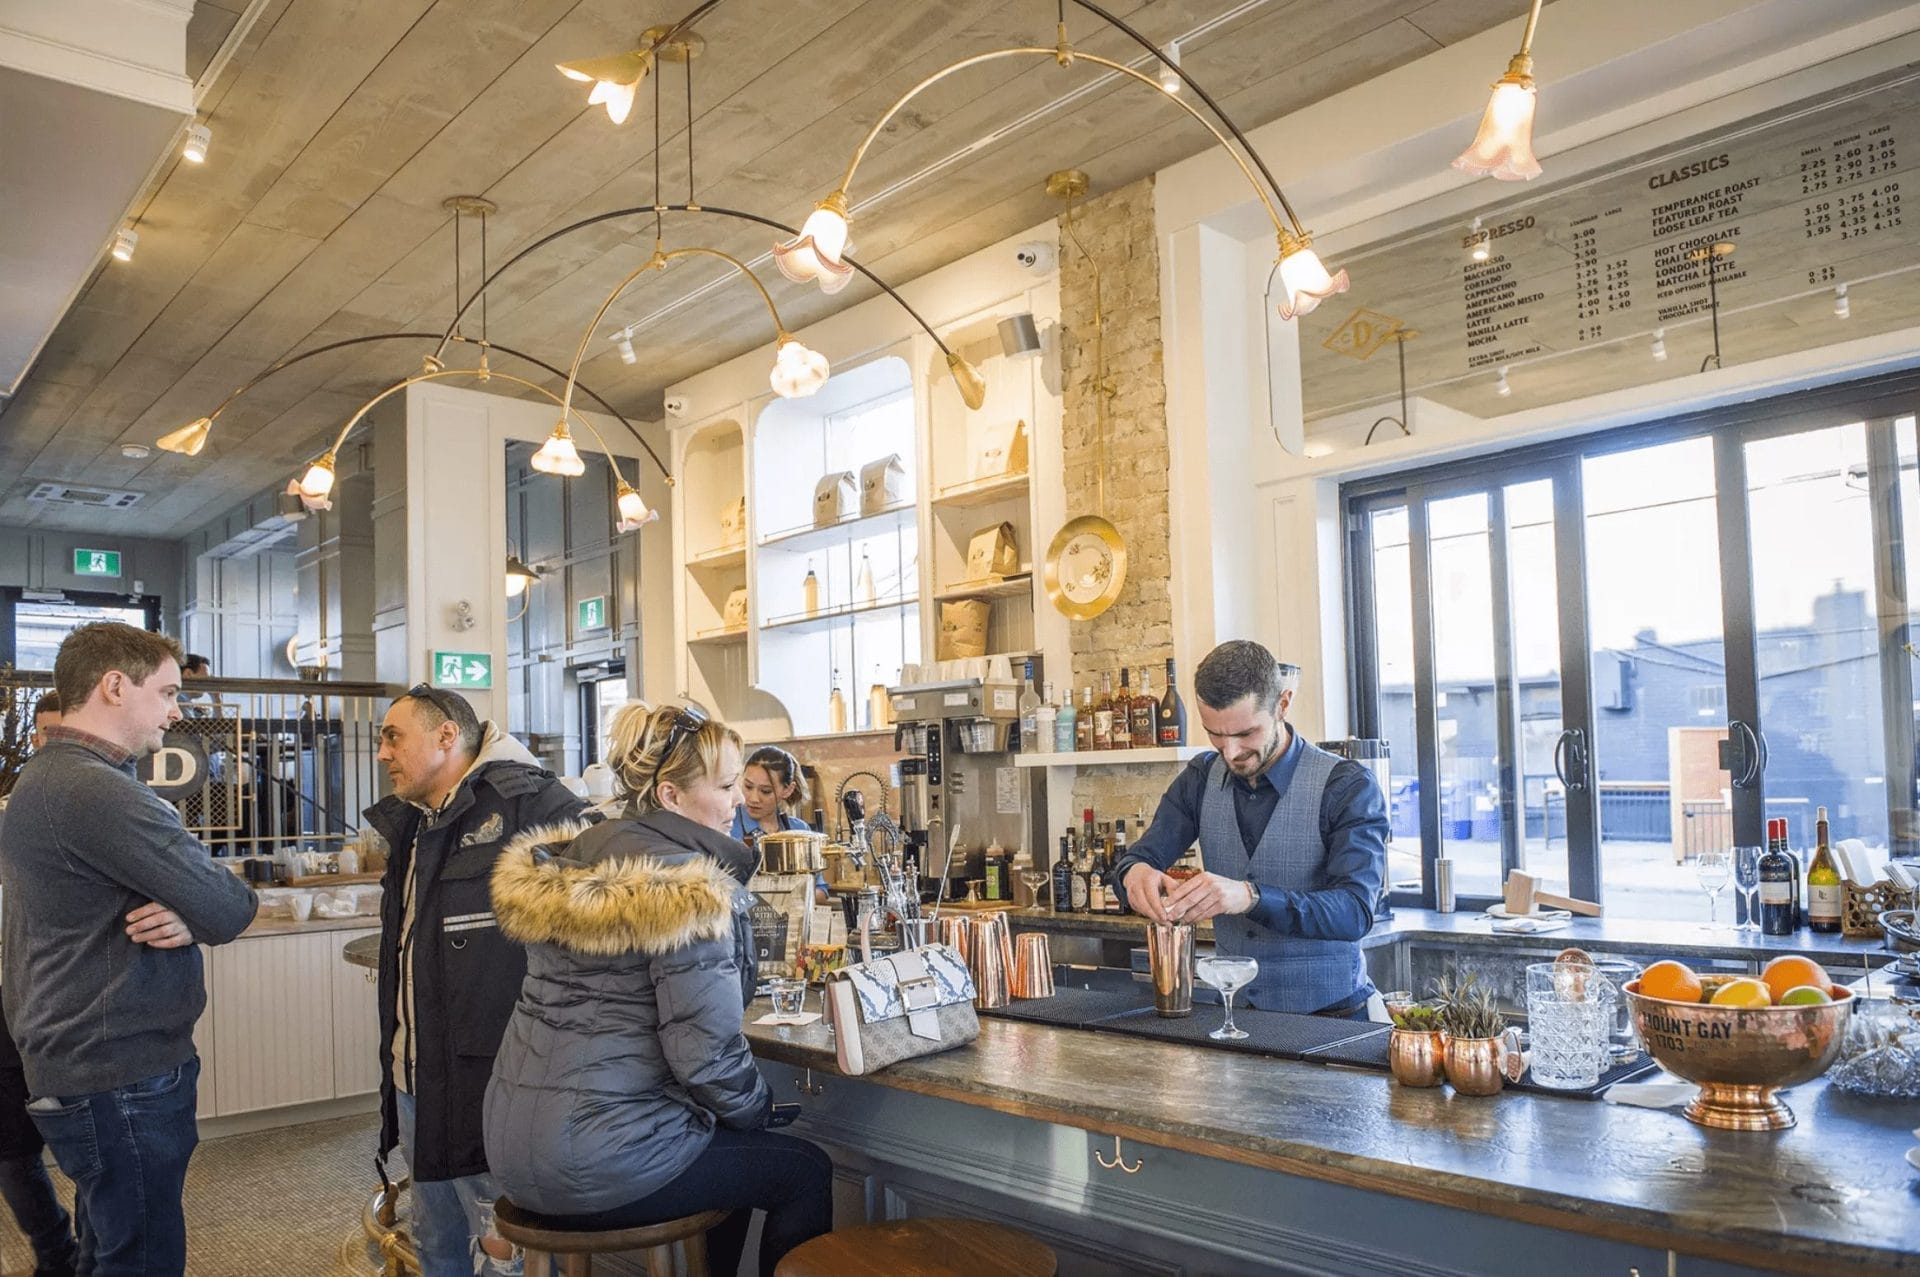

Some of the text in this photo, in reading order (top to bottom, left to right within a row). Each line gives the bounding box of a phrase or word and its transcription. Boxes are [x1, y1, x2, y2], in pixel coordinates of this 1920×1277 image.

[1868, 125, 1890, 136] LARGE
[1801, 138, 1894, 172] 2.25 2.60 2.85
[1802, 149, 1896, 182] 2.52 2.90 3.05
[1648, 154, 1730, 190] CLASSICS
[1803, 161, 1896, 194] 2.75 2.75 2.75
[1652, 177, 1760, 216] TEMPERANCE ROAST
[1804, 183, 1899, 216] 3.50 3.75 4.00
[1652, 193, 1744, 226] FEATURED ROAST
[1805, 195, 1900, 226] 3.75 3.95 4.10
[1462, 216, 1535, 249] ESPRESSO
[1653, 206, 1738, 237] LOOSE LEAF TEA
[1806, 206, 1900, 238] 3.95 4.35 4.55
[1842, 218, 1901, 240] 3.75 4.15
[1573, 228, 1595, 240] 3.00
[1574, 238, 1595, 250] 3.33
[1654, 226, 1740, 258] HOT CHOCOLATE
[1464, 255, 1504, 272] ESPRESSO
[1575, 248, 1596, 259] 3.50
[1576, 258, 1598, 270] 3.90
[1655, 245, 1715, 268] CHAI LATTE
[1464, 263, 1511, 282] MACCHIATO
[1576, 259, 1628, 280] 3.25 3.52
[1607, 270, 1628, 280] 3.95
[1656, 254, 1724, 278] LONDON FOG
[1657, 261, 1735, 288] MATCHA LATTE
[1464, 276, 1502, 291] CORTADO
[1465, 281, 1517, 301] CAPPUCCINO
[1578, 280, 1629, 299] 3.95 4.25
[1658, 270, 1746, 298] ICED OPTIONS AVAILABLE
[1466, 291, 1514, 310] AMERICANO
[1466, 292, 1544, 320] AMERICANO MISTO
[1578, 290, 1630, 308] 4.00 4.50
[1578, 300, 1631, 318] 4.91 5.40
[1658, 298, 1708, 314] VANILLA SHOT
[1659, 302, 1720, 321] CHOCOLATE SHOT
[1353, 320, 1372, 348] D
[1467, 317, 1491, 329] LATTE
[1467, 316, 1529, 338] VANILLA LATTE
[1468, 335, 1497, 348] MOCHA
[147, 748, 196, 786] D
[760, 948, 768, 957] D
[1643, 1011, 1732, 1040] MOUNT GAY
[1656, 1034, 1684, 1052] 1703
